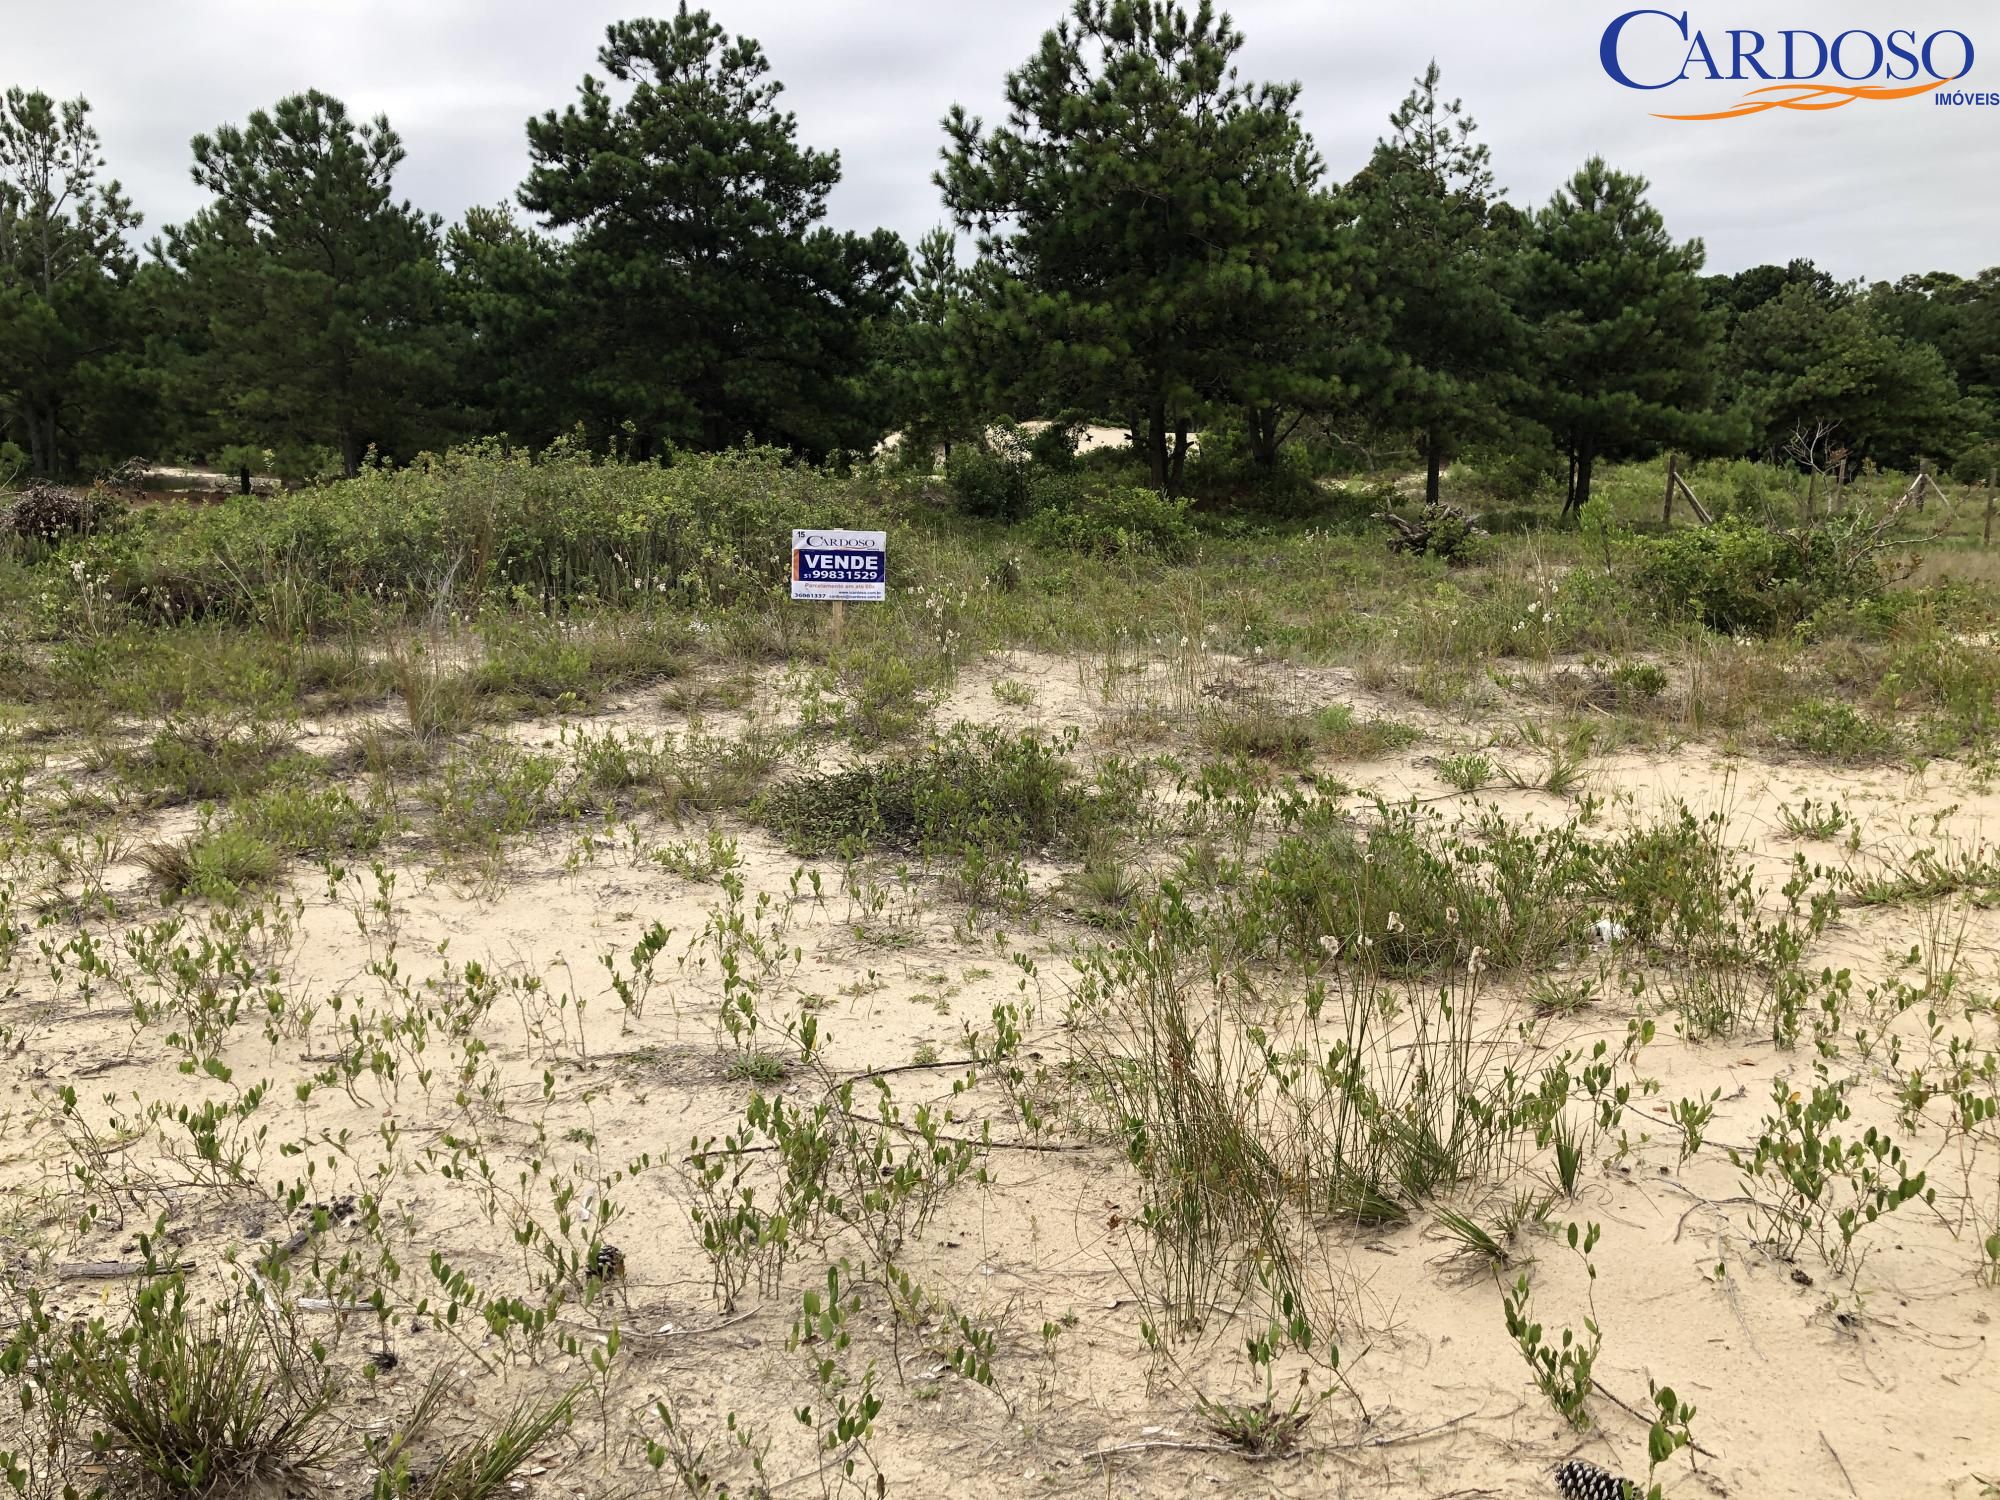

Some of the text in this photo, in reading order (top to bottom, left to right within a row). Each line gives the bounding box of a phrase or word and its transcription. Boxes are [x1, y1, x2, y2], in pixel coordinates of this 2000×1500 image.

[806, 535, 875, 547] CARDOSO
[804, 554, 878, 570] VENDE
[812, 570, 878, 580] 99831529
